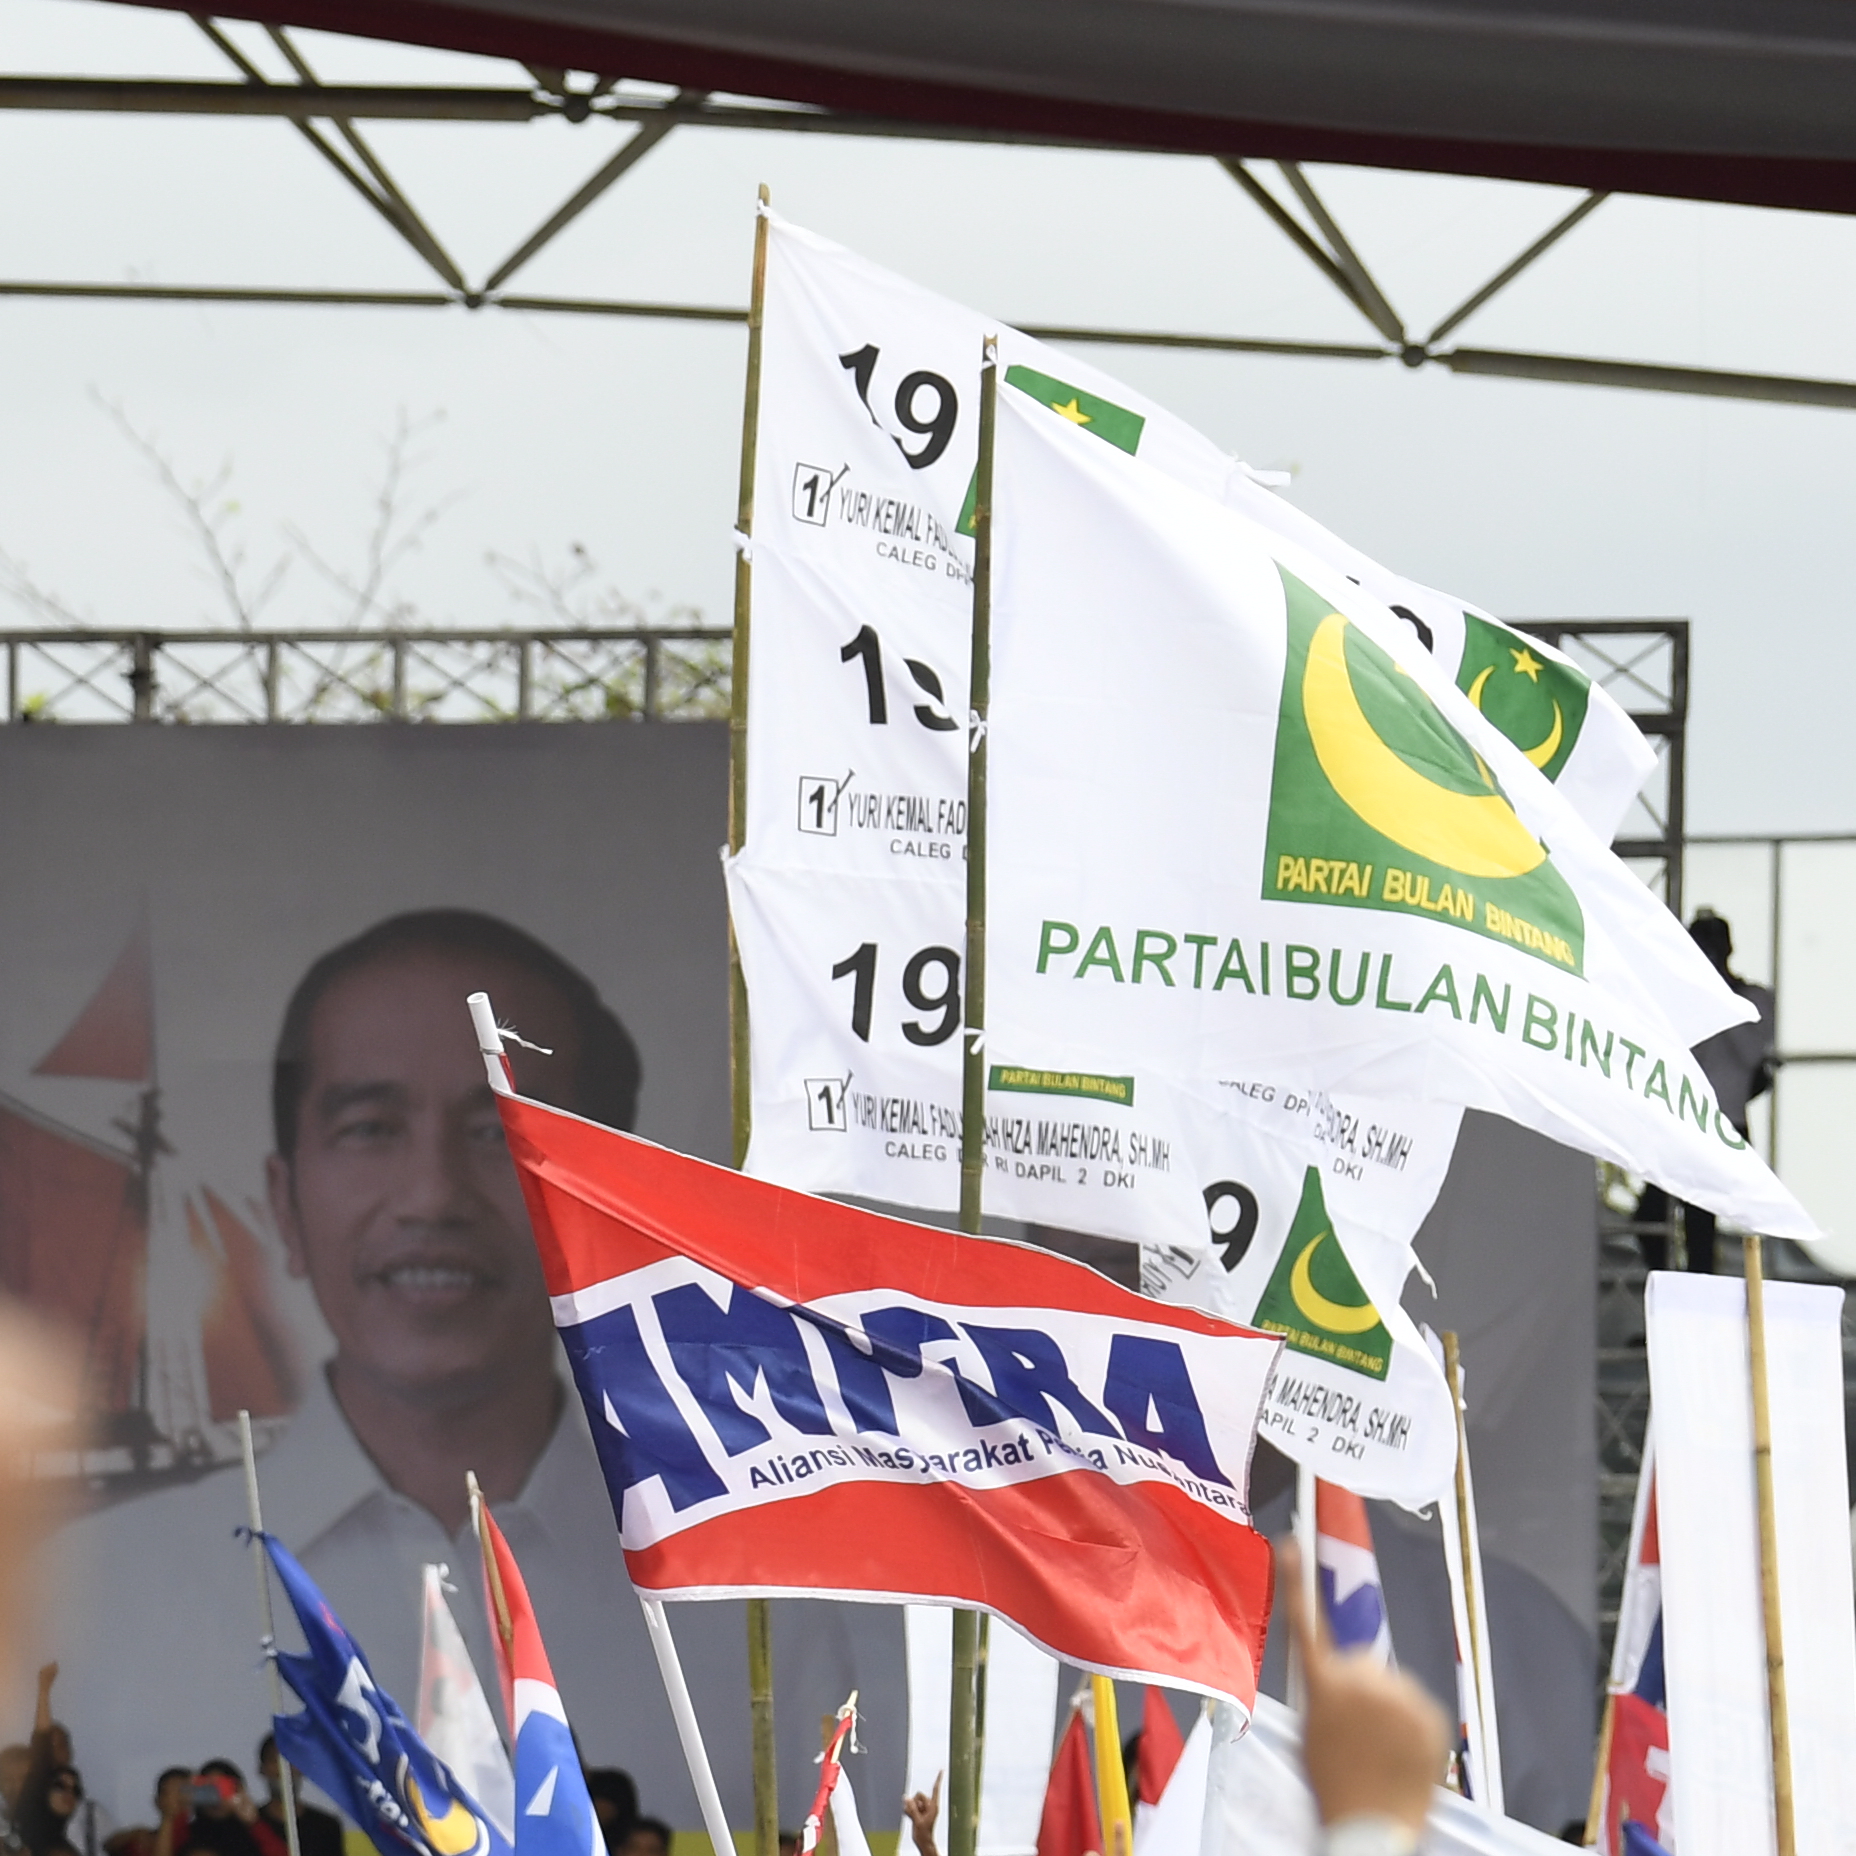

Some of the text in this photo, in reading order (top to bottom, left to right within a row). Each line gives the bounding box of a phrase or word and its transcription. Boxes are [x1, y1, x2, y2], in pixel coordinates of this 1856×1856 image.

[840, 487, 873, 528] YURI
[873, 497, 922, 541] KEMAL
[876, 541, 938, 571] CALEG
[848, 792, 882, 829] YURI
[885, 795, 934, 834] KEMAL
[890, 838, 951, 860] CALEG
[1276, 854, 1576, 967] PARTAI BULAN BINTANG
[831, 942, 962, 1047] 19
[1035, 919, 1271, 998] PARTAI
[1284, 943, 1511, 1035] BULAN
[851, 1091, 878, 1128] YURI
[879, 1096, 929, 1136] KEMAL
[885, 1140, 948, 1161] CALEG
[1015, 1160, 1067, 1185] DAPIL
[1077, 1168, 1088, 1185] 2
[1103, 1169, 1136, 1189] DKI
[1332, 1155, 1365, 1183] DKI
[1259, 1408, 1366, 1461] APIL 2 DKI
[749, 1442, 855, 1490] Aliansi
